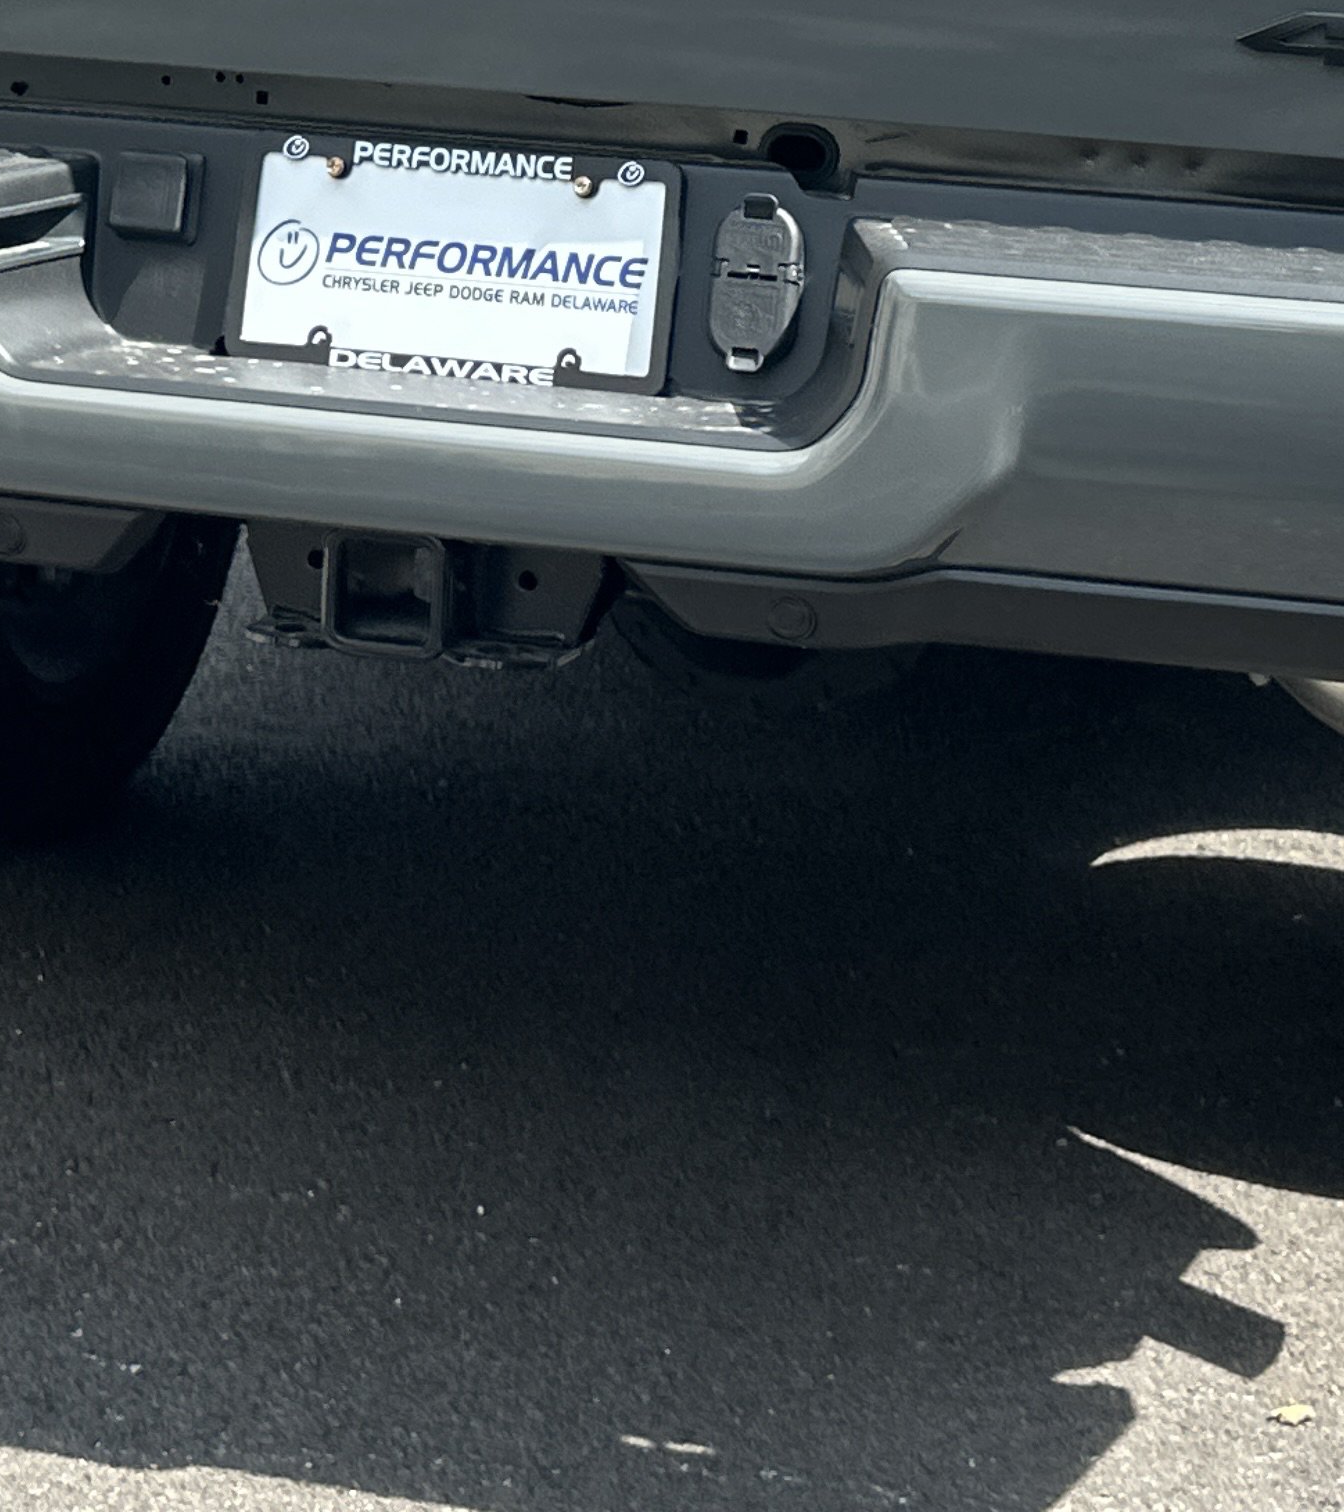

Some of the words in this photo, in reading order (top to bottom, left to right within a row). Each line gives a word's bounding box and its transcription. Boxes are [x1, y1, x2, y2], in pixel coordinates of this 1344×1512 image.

[353, 140, 573, 180] PERFORMANCE
[325, 232, 649, 289] PERFORMANCE
[322, 273, 400, 295] CHRYSLER
[405, 281, 444, 298] JEEP
[449, 285, 504, 304] DODGE
[509, 289, 545, 308] RAM
[551, 295, 640, 316] DELAWARE
[329, 347, 555, 387] DELAWARE
